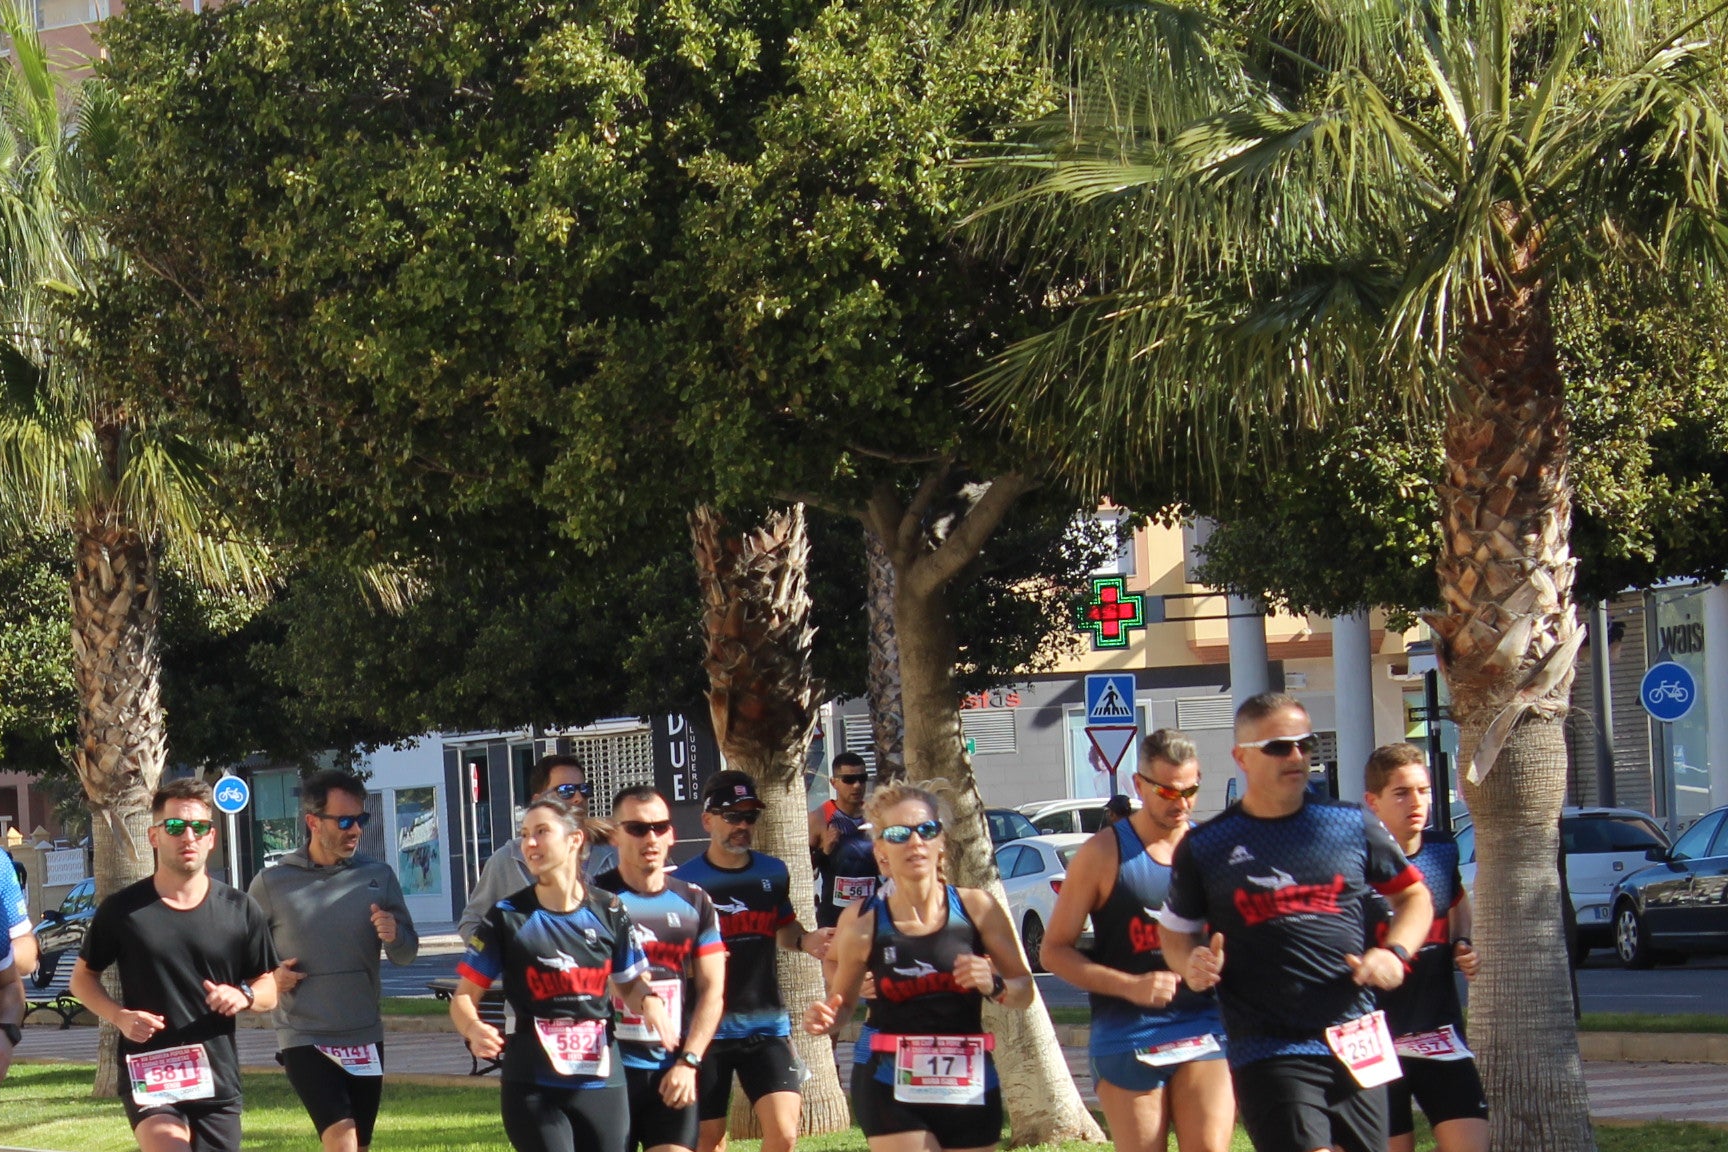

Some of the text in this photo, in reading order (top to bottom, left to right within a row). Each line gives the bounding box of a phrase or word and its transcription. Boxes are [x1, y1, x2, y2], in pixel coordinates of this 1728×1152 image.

[1660, 613, 1705, 655] wais
[849, 886, 863, 896] 56
[556, 1034, 593, 1051] 582
[1348, 1036, 1373, 1060] 251
[151, 1063, 188, 1083] 581
[927, 1056, 955, 1076] 17
